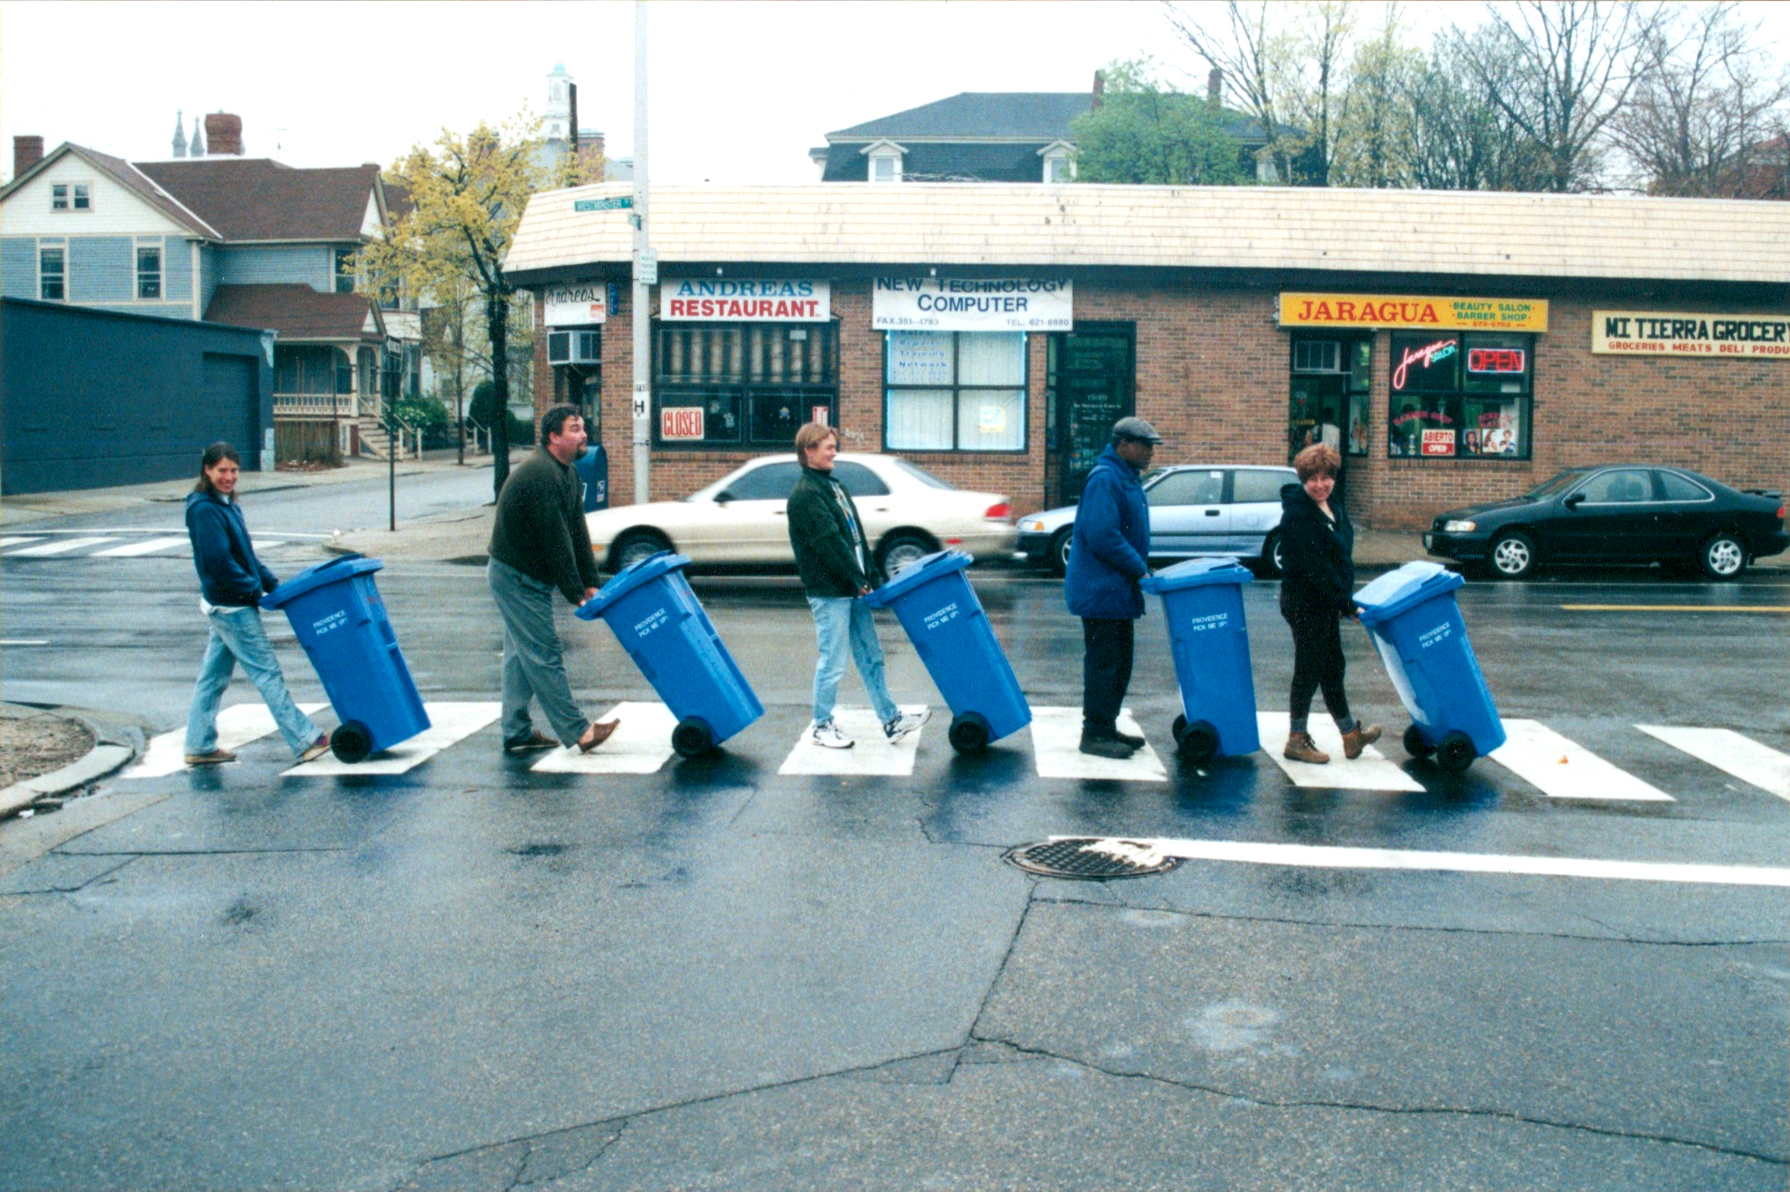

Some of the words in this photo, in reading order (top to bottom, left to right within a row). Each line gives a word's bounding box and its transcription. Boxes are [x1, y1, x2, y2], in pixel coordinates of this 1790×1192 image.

[677, 280, 813, 297] ANDREAS
[877, 277, 923, 291] NEW
[937, 278, 1066, 293] TECHNOLOGY
[546, 287, 600, 306] Andreas
[917, 294, 1028, 312] COMPUTER
[670, 299, 819, 317] RESTAURANT
[1298, 301, 1439, 323] JARAGUA
[1453, 302, 1493, 311] BEAUTY
[1498, 304, 1531, 312] SALON
[1456, 312, 1496, 320] BARBER
[1500, 313, 1527, 322] SHOP
[1606, 317, 1631, 339] MI
[1635, 318, 1709, 340] TIERRA
[1608, 341, 1665, 351] GROCERIES
[1672, 343, 1712, 353] MEATS
[1719, 344, 1745, 354] DELI
[1752, 346, 1790, 355] PRODU
[1469, 349, 1523, 372] OPEN
[663, 411, 702, 436] CLOSED
[1424, 431, 1453, 442] ABIERTO
[1428, 444, 1448, 453] OPEN
[312, 609, 346, 630] PROVIDENCE
[634, 607, 666, 631] PROVIDENCE
[923, 602, 957, 623] PROVIDENCE
[940, 615, 949, 623] ME
[1192, 612, 1228, 624] PROVIDENCE
[329, 622, 337, 630] ME
[650, 621, 659, 630] ME
[1419, 621, 1450, 641] PROVIDENCE
[1434, 634, 1443, 642] ME
